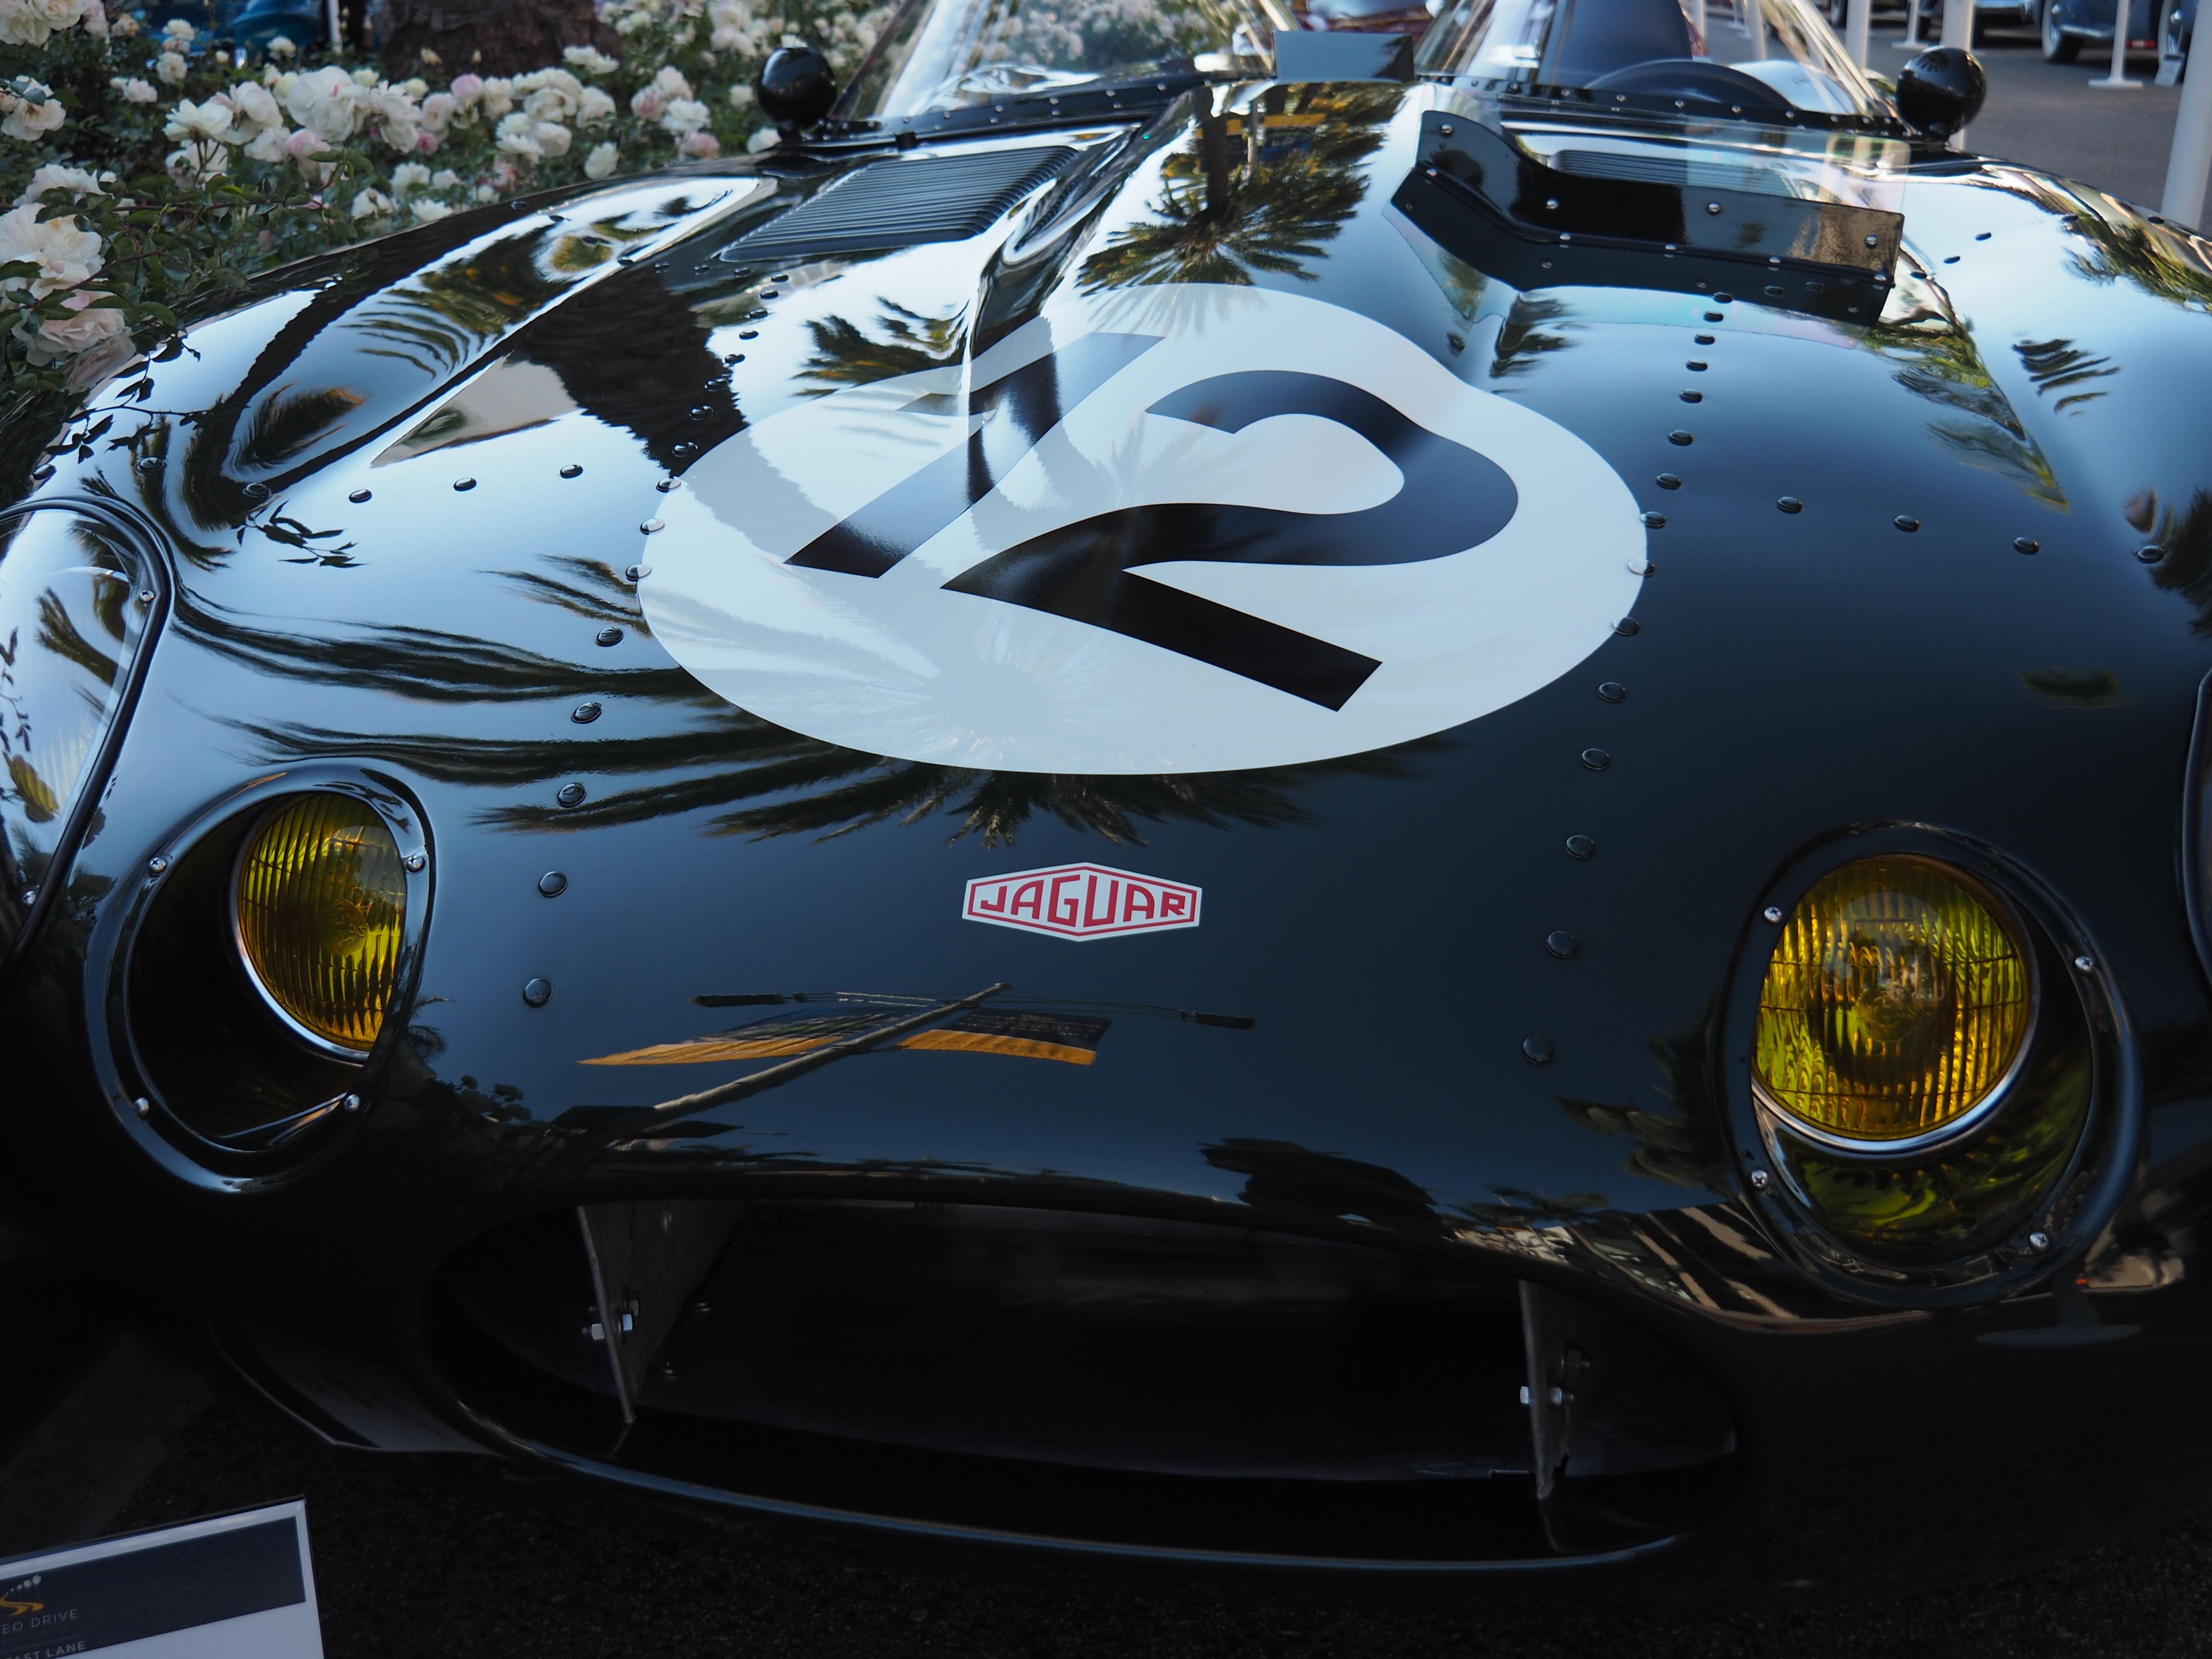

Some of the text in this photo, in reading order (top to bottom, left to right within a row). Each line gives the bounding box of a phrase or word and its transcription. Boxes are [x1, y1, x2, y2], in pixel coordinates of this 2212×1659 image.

[783, 332, 1519, 712] 12
[980, 874, 1186, 927] JAGUAR
[31, 1608, 78, 1628] DRIVE
[47, 1640, 86, 1658] LANE
